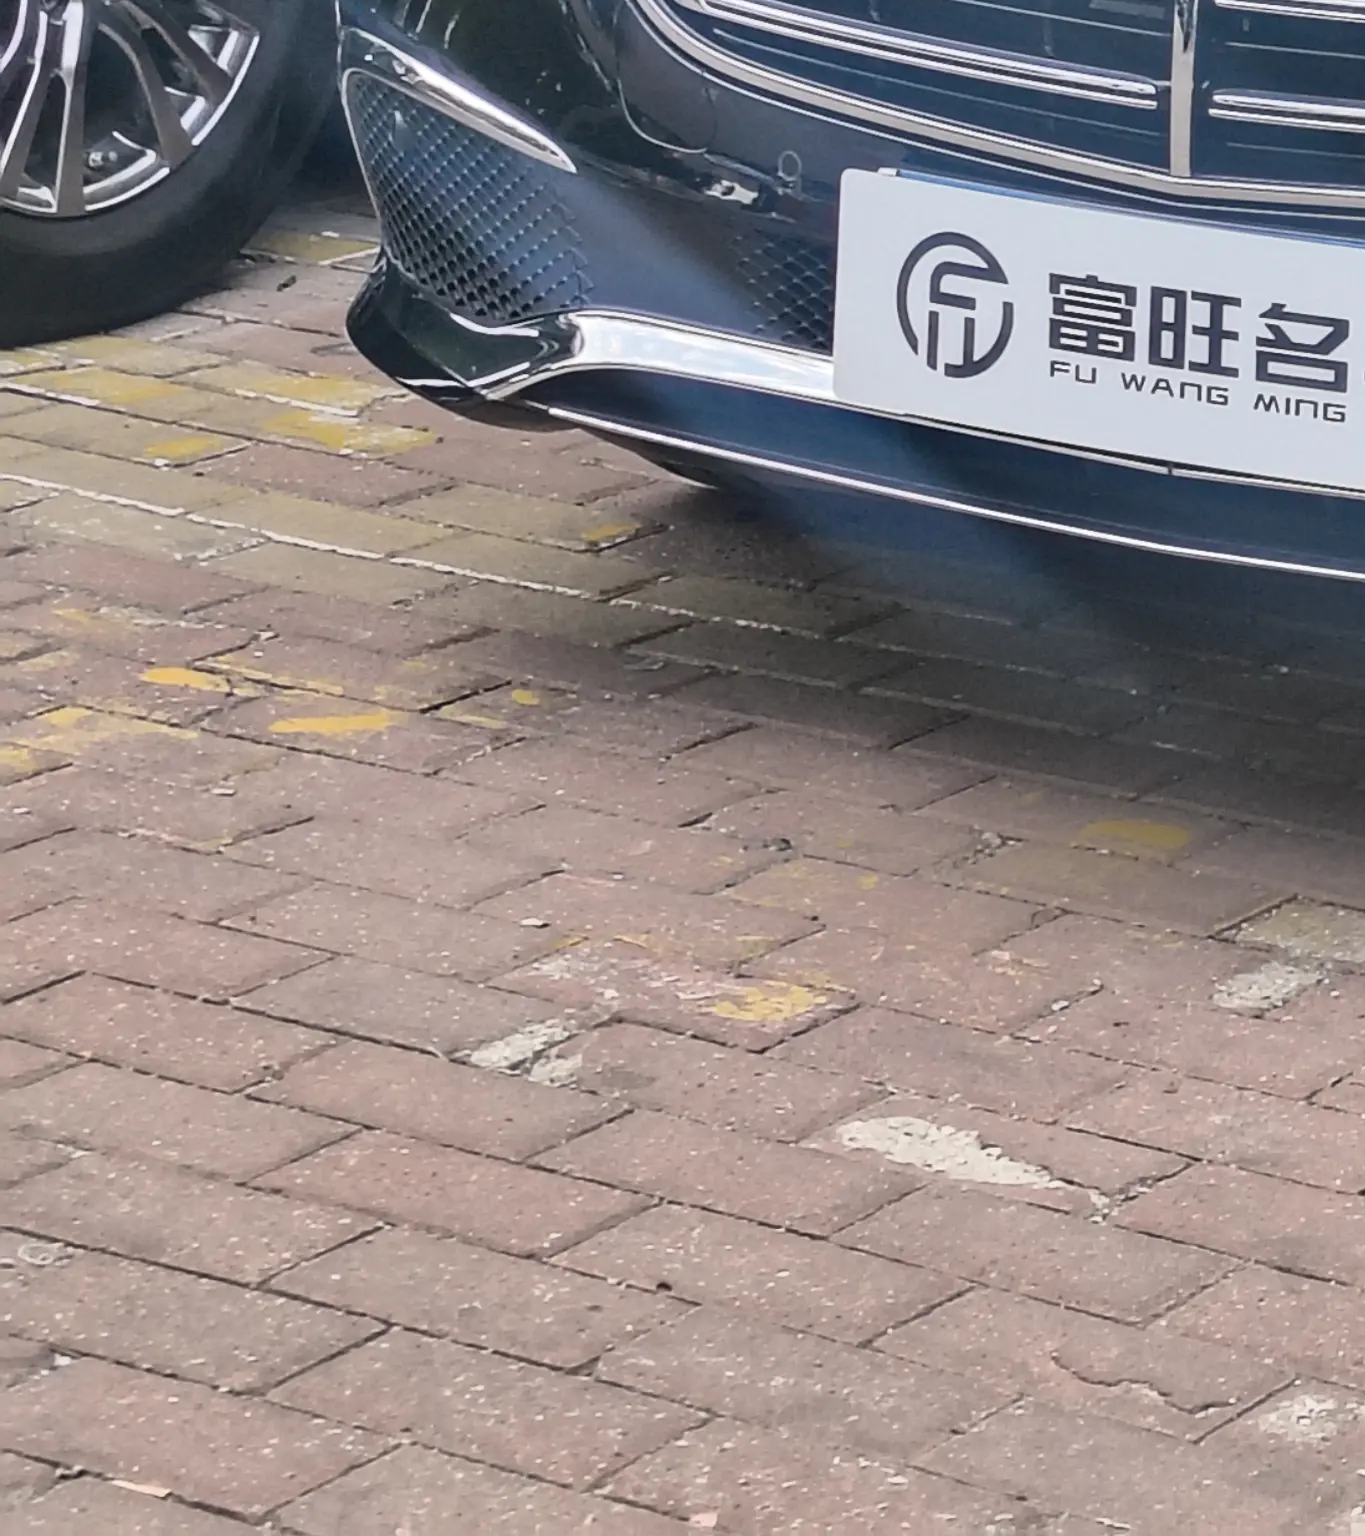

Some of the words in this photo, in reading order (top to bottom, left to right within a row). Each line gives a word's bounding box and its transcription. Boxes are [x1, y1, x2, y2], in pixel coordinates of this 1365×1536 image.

[1050, 360, 1096, 385] FU
[1121, 373, 1230, 407] WANG
[1253, 393, 1346, 424] MING
